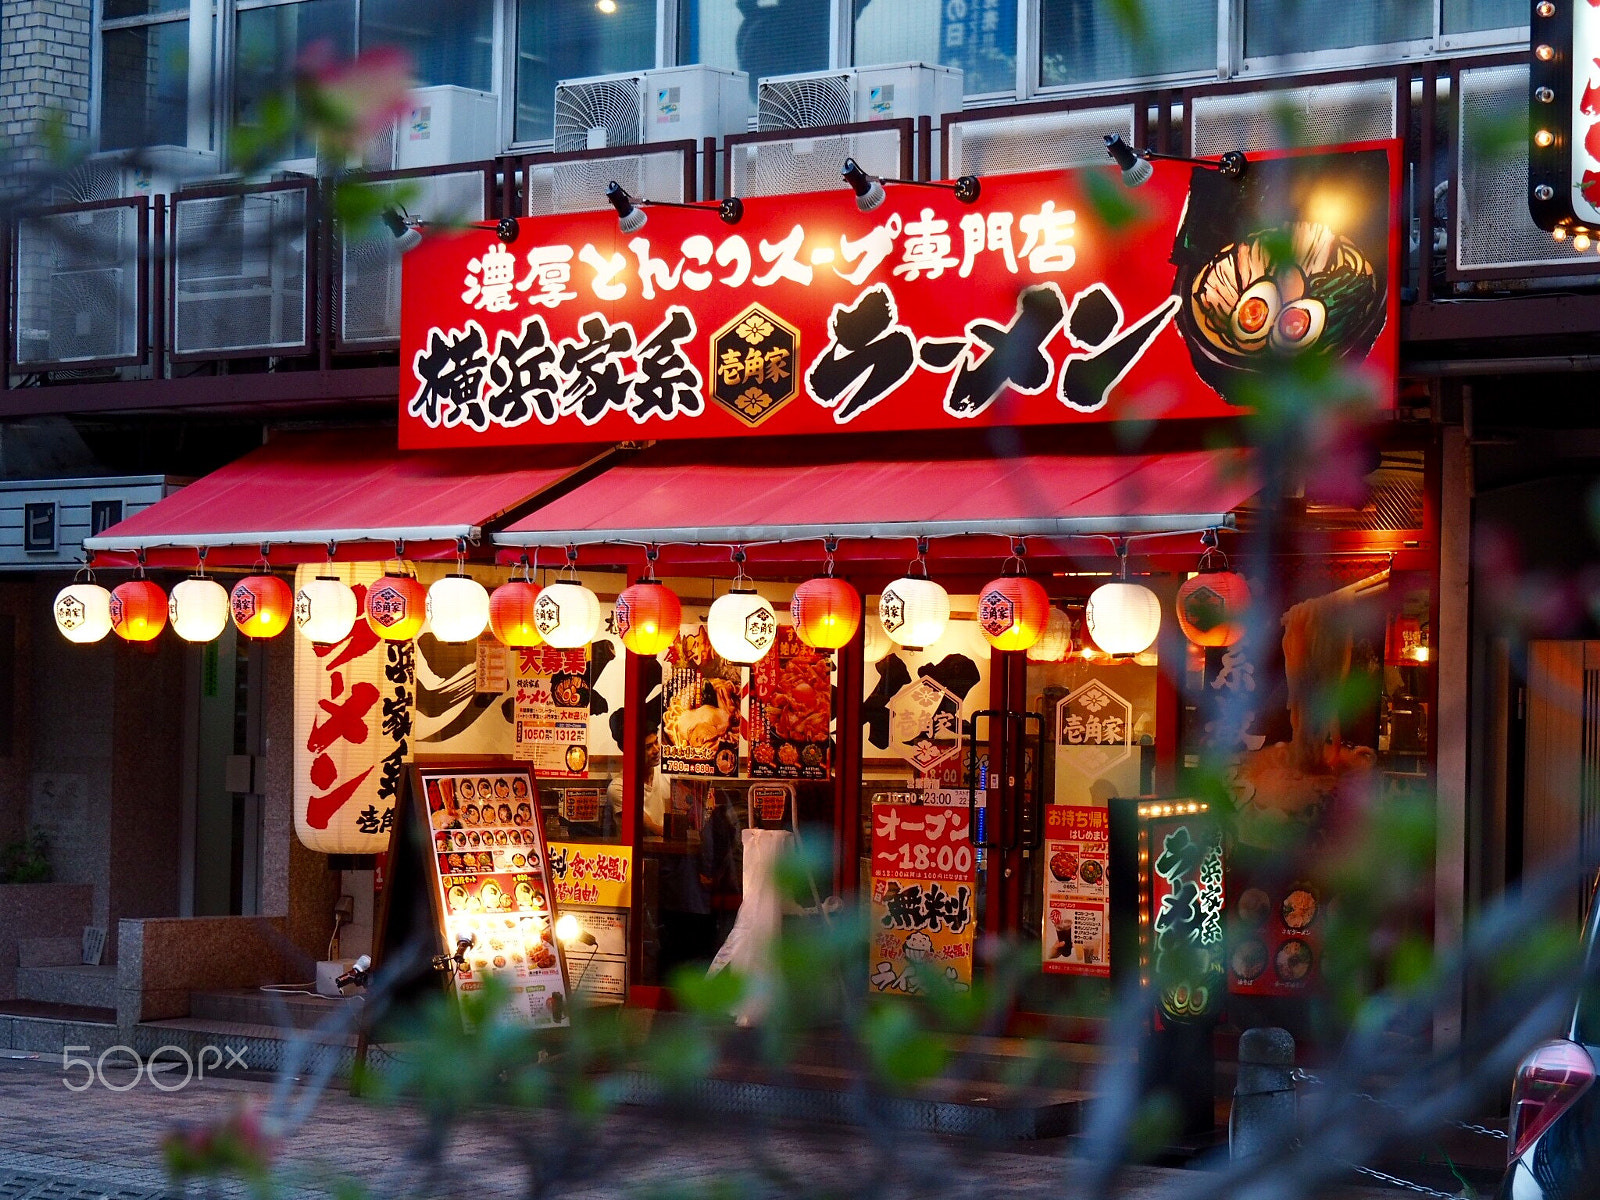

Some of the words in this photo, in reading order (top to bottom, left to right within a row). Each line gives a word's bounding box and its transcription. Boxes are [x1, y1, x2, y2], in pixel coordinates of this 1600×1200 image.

[407, 304, 705, 432] 横浜家系
[717, 345, 791, 386] 壱角家
[804, 281, 1183, 425] ラーメン
[1063, 713, 1125, 745] 壱角家
[924, 792, 952, 805] 23:00
[876, 807, 970, 842] オープン
